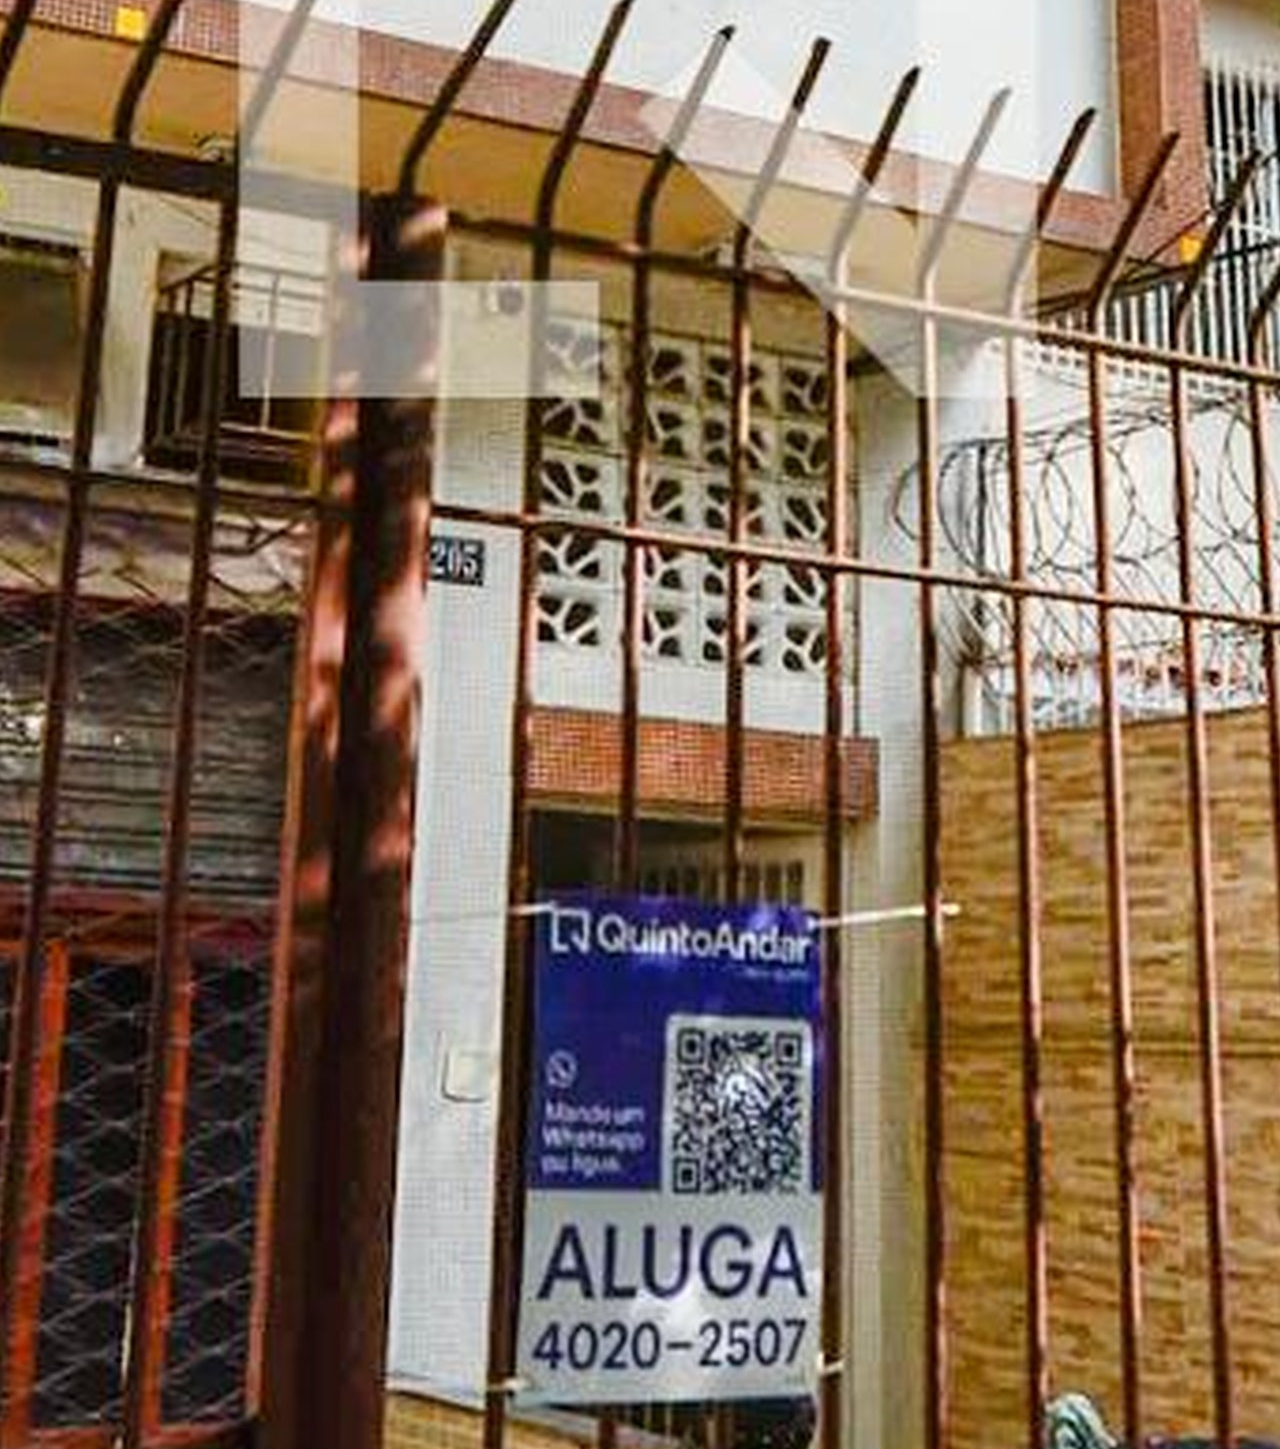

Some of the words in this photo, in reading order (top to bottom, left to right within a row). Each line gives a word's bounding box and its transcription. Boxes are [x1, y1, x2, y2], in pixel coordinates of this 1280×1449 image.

[430, 537, 478, 577] 205
[597, 914, 812, 963] QuintoAndar
[536, 1224, 807, 1299] ALUGA
[532, 1319, 808, 1370] 4020-2507
